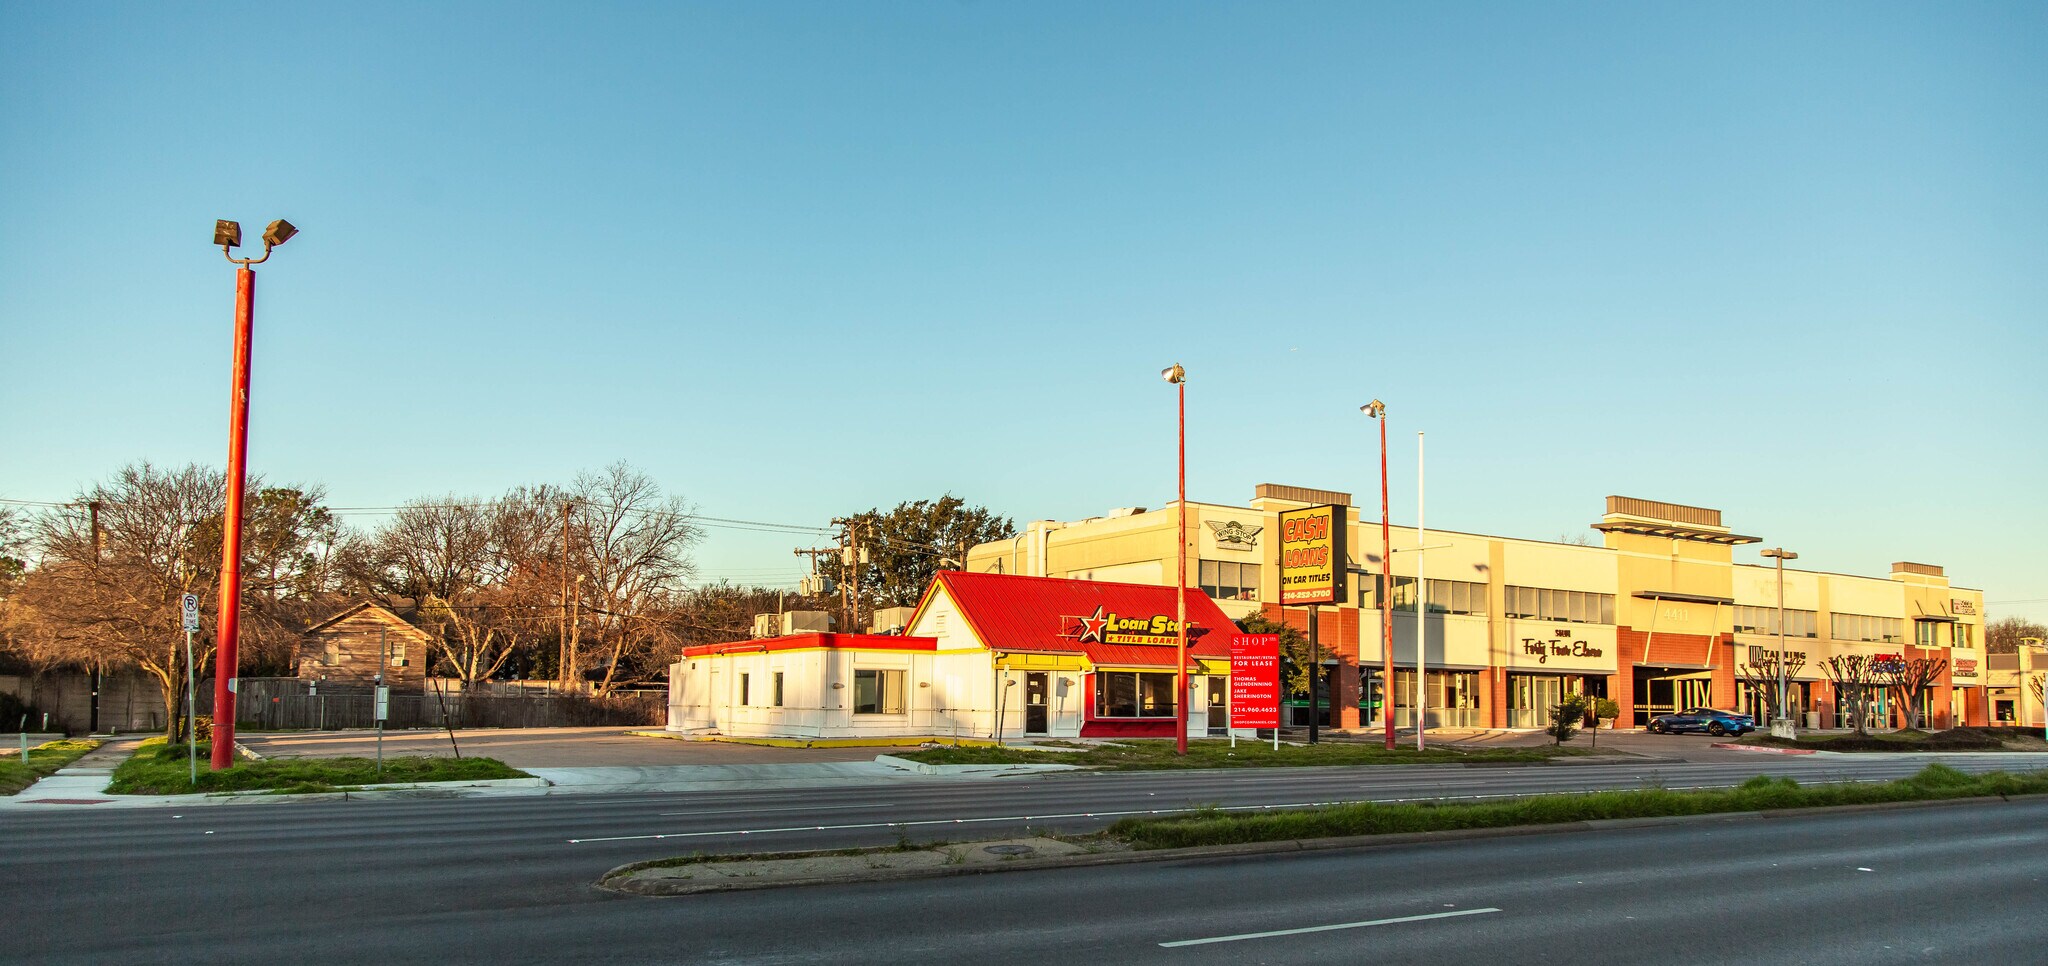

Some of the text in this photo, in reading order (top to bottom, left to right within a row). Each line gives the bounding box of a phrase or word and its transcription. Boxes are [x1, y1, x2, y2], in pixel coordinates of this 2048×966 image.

[1217, 528, 1251, 540] WING STOP
[1282, 573, 1331, 585] ON CAR TITLES
[1664, 607, 1689, 621] 4411
[1106, 613, 1149, 632] Loan
[1233, 637, 1268, 646] SHOP
